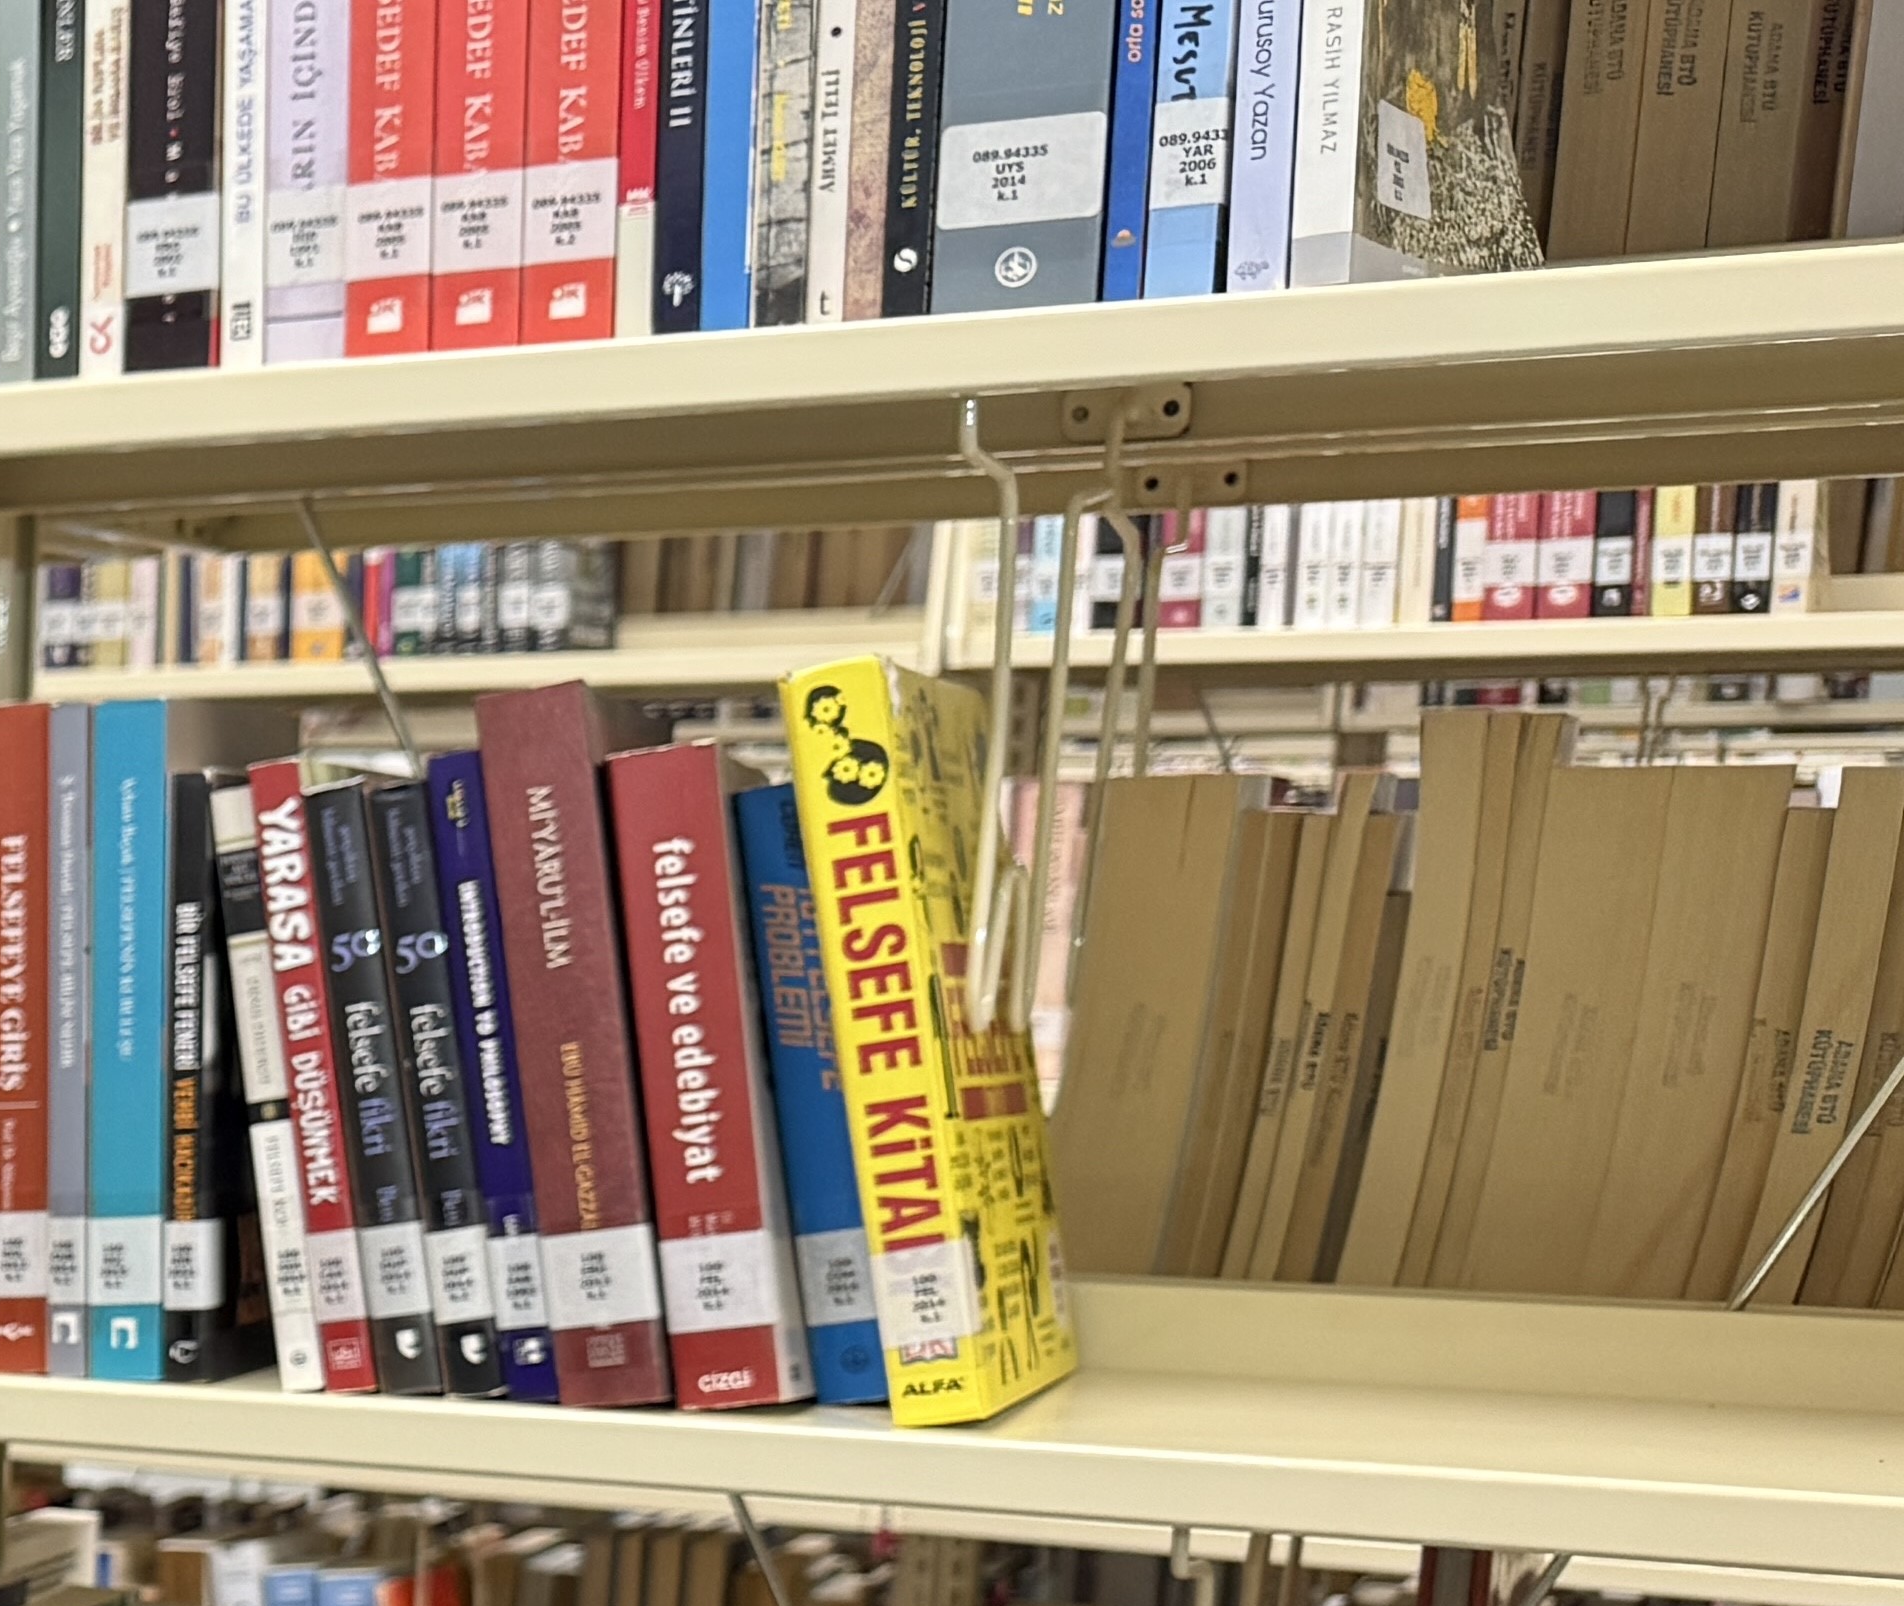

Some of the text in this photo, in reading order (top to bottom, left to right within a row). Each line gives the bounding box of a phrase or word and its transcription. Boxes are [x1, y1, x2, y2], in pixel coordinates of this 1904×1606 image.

[290, 0, 322, 101] İÇİND
[1610, 0, 1627, 46] DANA
[1249, 0, 1276, 161] urusoy Yazan
[1319, 6, 1343, 155] RASİH YILMAZ
[373, 107, 401, 184] KABA
[464, 94, 491, 178] KABA
[820, 128, 837, 193] AHMET
[973, 145, 1048, 163] 089.94335
[995, 162, 1025, 174] UYS
[1179, 159, 1216, 173] 2006
[1182, 147, 1214, 157] YAR
[239, 194, 252, 225] BU
[992, 175, 1026, 188] 2014
[997, 190, 1018, 200] k.1
[1185, 174, 1207, 186] k.1
[0, 834, 29, 1003] FELSEFEYE
[258, 797, 315, 972] YARASA
[457, 880, 493, 1007] INTRODUCTION
[475, 1010, 497, 1037] TO
[282, 983, 319, 1041] GİBİ
[652, 838, 723, 1185] felsefe ve edebiyat
[827, 811, 945, 1252] FELSEFE KİTA
[344, 1001, 394, 1156] felsefe fikri
[408, 1003, 459, 1160] felsefe fikri
[1816, 1040, 1854, 1124] ADANA BTÜ
[290, 1052, 336, 1207] DÜŞÜNMEK
[902, 1377, 962, 1397] ALFA
